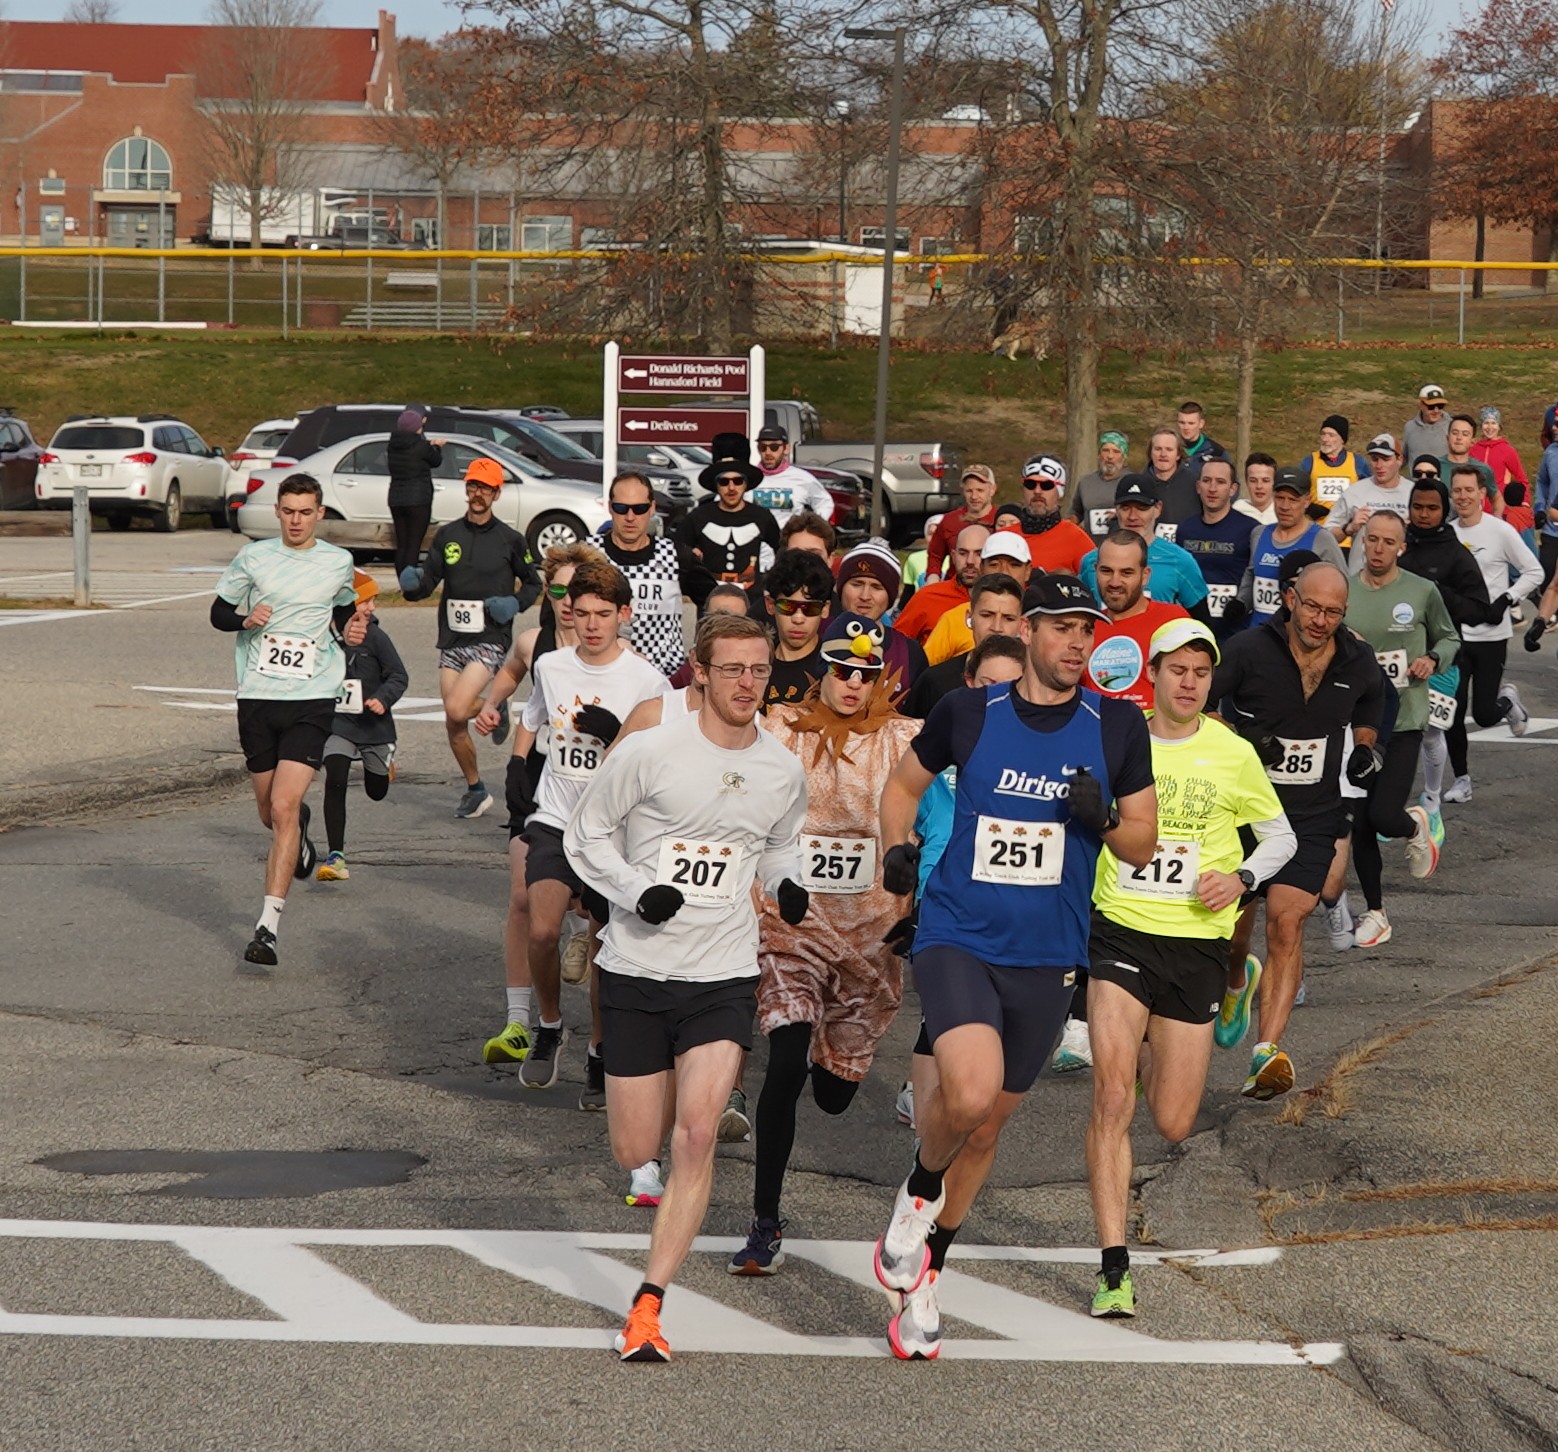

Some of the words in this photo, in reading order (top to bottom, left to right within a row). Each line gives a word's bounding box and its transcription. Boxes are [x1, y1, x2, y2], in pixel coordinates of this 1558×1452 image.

[649, 363, 683, 374] Donald
[683, 364, 724, 375] Richards
[724, 364, 746, 375] Pool
[649, 376, 698, 388] Hannaford
[699, 377, 723, 388] Field
[649, 419, 699, 431] Deliveries
[1322, 484, 1344, 495] 229
[637, 602, 659, 612] CLUB
[454, 610, 471, 625] 98
[268, 646, 305, 669] 262
[558, 746, 598, 771] 168
[1162, 818, 1194, 832] BEACON
[988, 839, 1044, 869] 251
[671, 857, 728, 888] 207
[810, 853, 862, 880] 257
